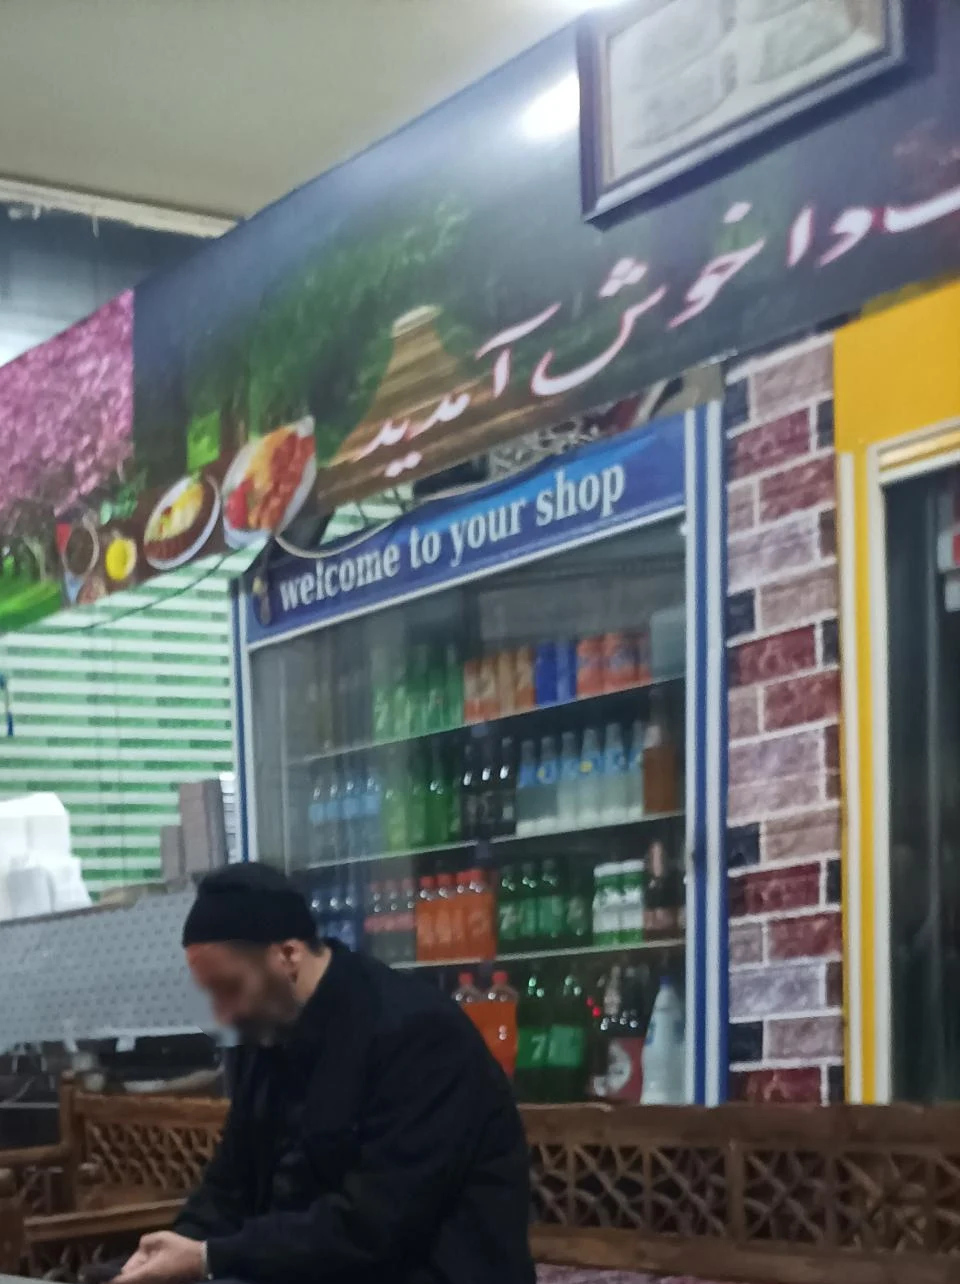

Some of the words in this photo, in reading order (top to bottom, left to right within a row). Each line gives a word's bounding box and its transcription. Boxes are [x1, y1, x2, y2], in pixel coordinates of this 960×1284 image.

[528, 201, 767, 397] خوش
[352, 303, 562, 477] آمدید
[279, 544, 402, 612] welcome
[410, 527, 441, 569] to
[449, 497, 528, 567] your
[535, 463, 625, 528] shop
